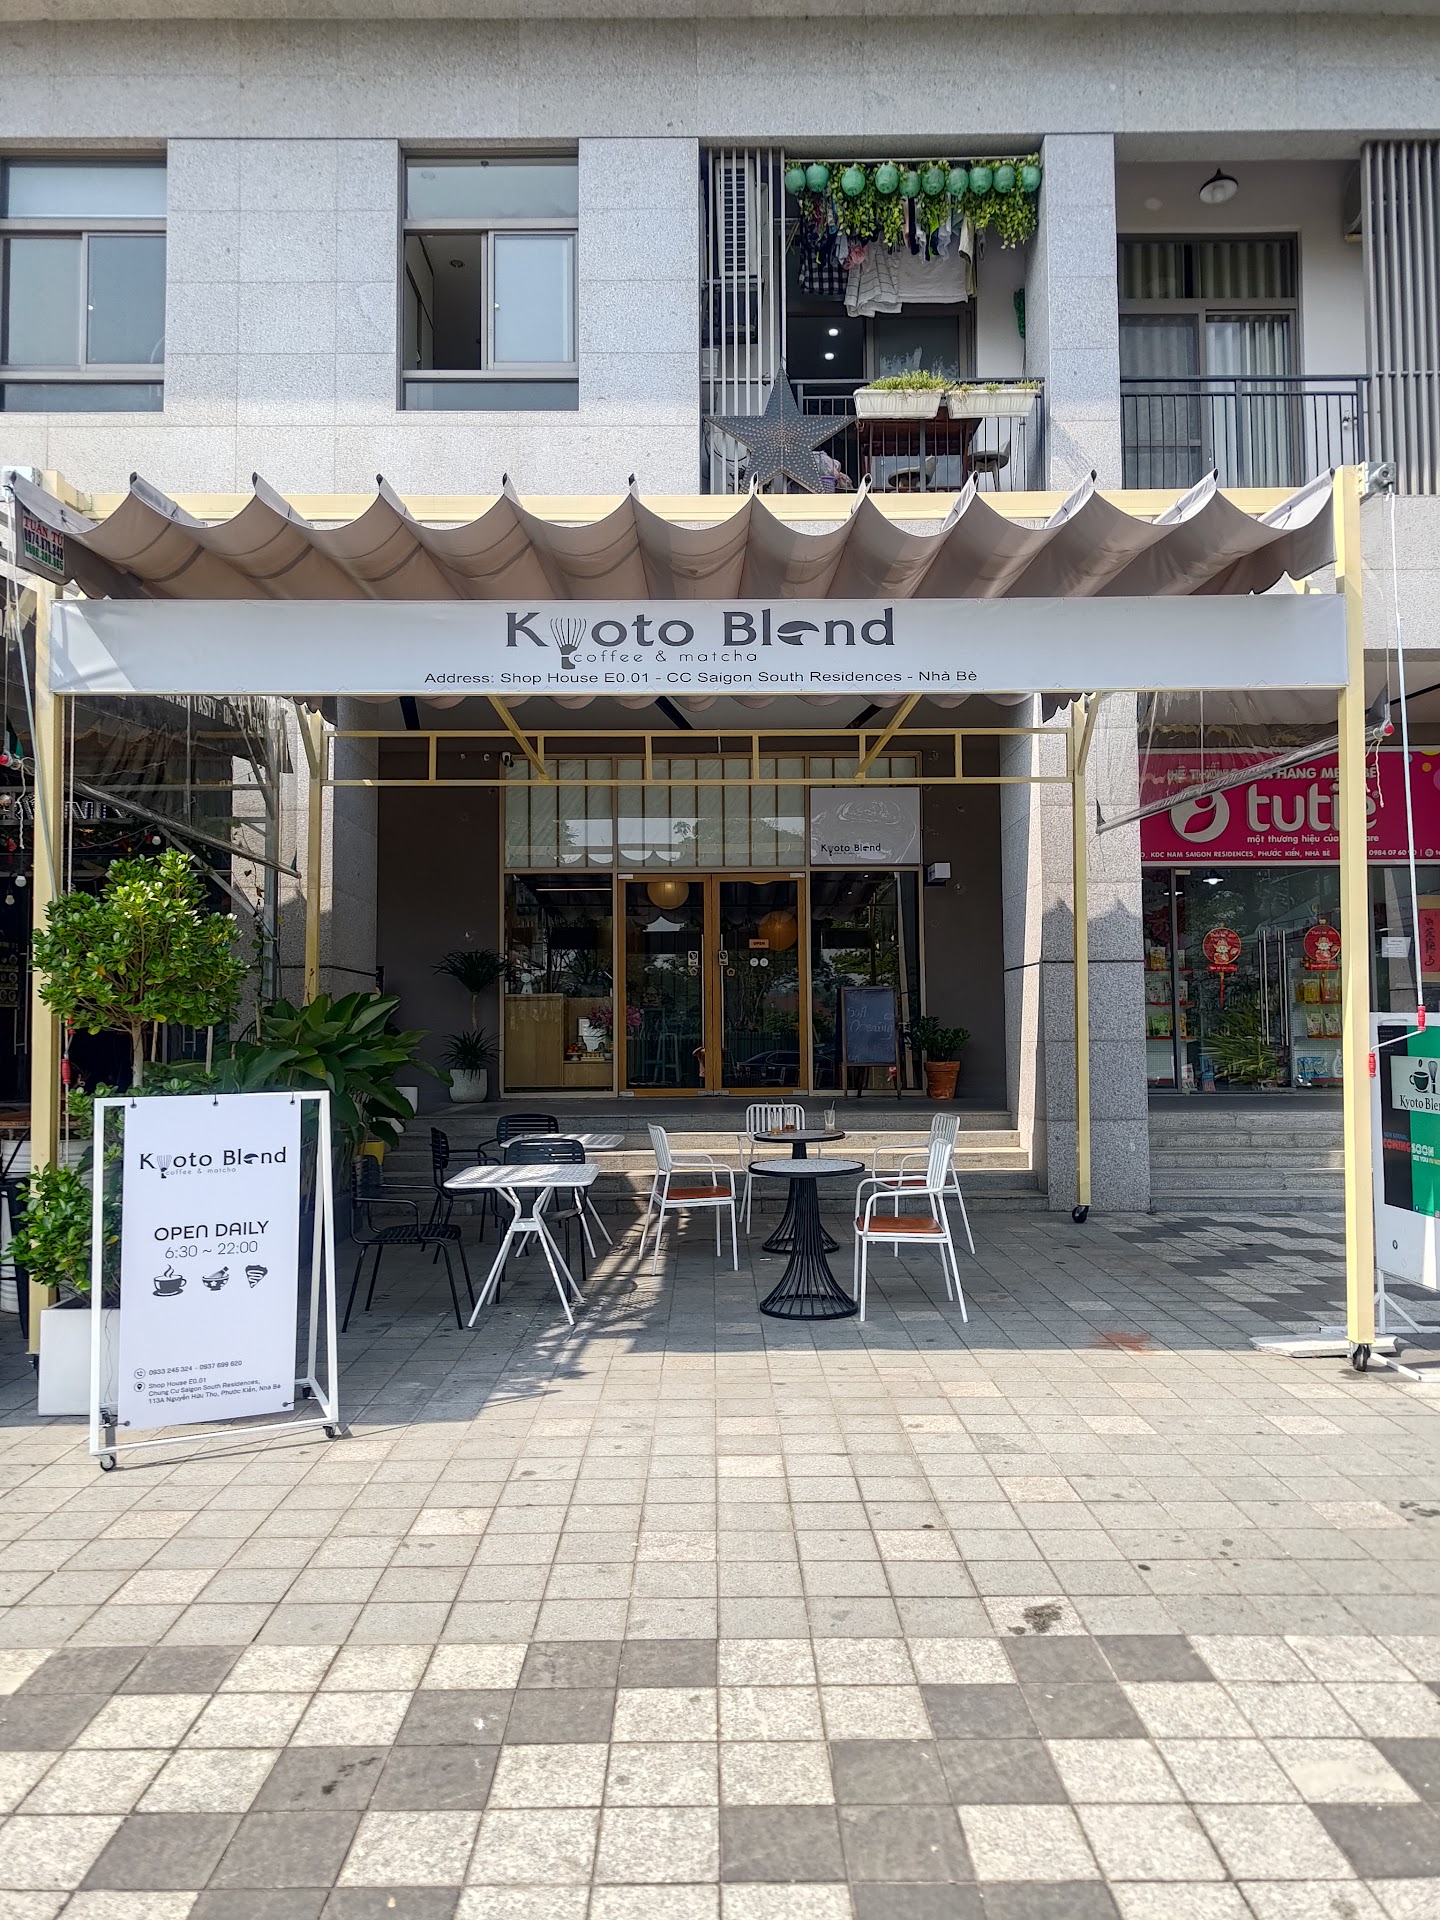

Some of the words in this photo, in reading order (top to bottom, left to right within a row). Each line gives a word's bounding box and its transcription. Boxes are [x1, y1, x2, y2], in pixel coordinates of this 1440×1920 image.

[505, 611, 695, 670] Kyoto
[722, 607, 896, 647] Blend
[573, 650, 644, 663] coffee
[655, 650, 667, 663] &
[679, 649, 758, 663] matcha
[424, 672, 495, 684] Address:
[500, 672, 542, 685] Shop
[547, 672, 599, 684] House
[604, 672, 649, 684] E0.01
[666, 672, 692, 684] CC
[697, 671, 752, 685] Saigon
[758, 671, 804, 683] South
[810, 670, 902, 683] Residences
[918, 670, 951, 682] Nhà
[956, 670, 978, 682] Bè
[1246, 834, 1265, 845] một
[1268, 834, 1299, 845] thương
[1301, 834, 1320, 845] hiệu
[821, 844, 850, 856] Kyoto
[854, 843, 881, 851] Blend
[1213, 851, 1256, 859] RESIDENCES,
[1399, 1094, 1424, 1110] Kyoto
[1383, 1138, 1411, 1152] COMING
[1411, 1142, 1435, 1157] SOON
[140, 1152, 213, 1178] Kyoto
[223, 1146, 287, 1166] Blend
[165, 1168, 192, 1176] coffee
[207, 1166, 237, 1174] matcha
[154, 1224, 208, 1241] OPEN
[215, 1220, 270, 1237] DAILY
[164, 1244, 198, 1259] 6:30
[217, 1240, 259, 1256] 22:00
[148, 1368, 166, 1376] 0933
[180, 1365, 193, 1373] 324
[199, 1363, 216, 1371] 0937
[148, 1390, 169, 1398] Chung
[180, 1385, 202, 1394] Saigon
[202, 1383, 222, 1391] South
[222, 1379, 261, 1388] Residences,
